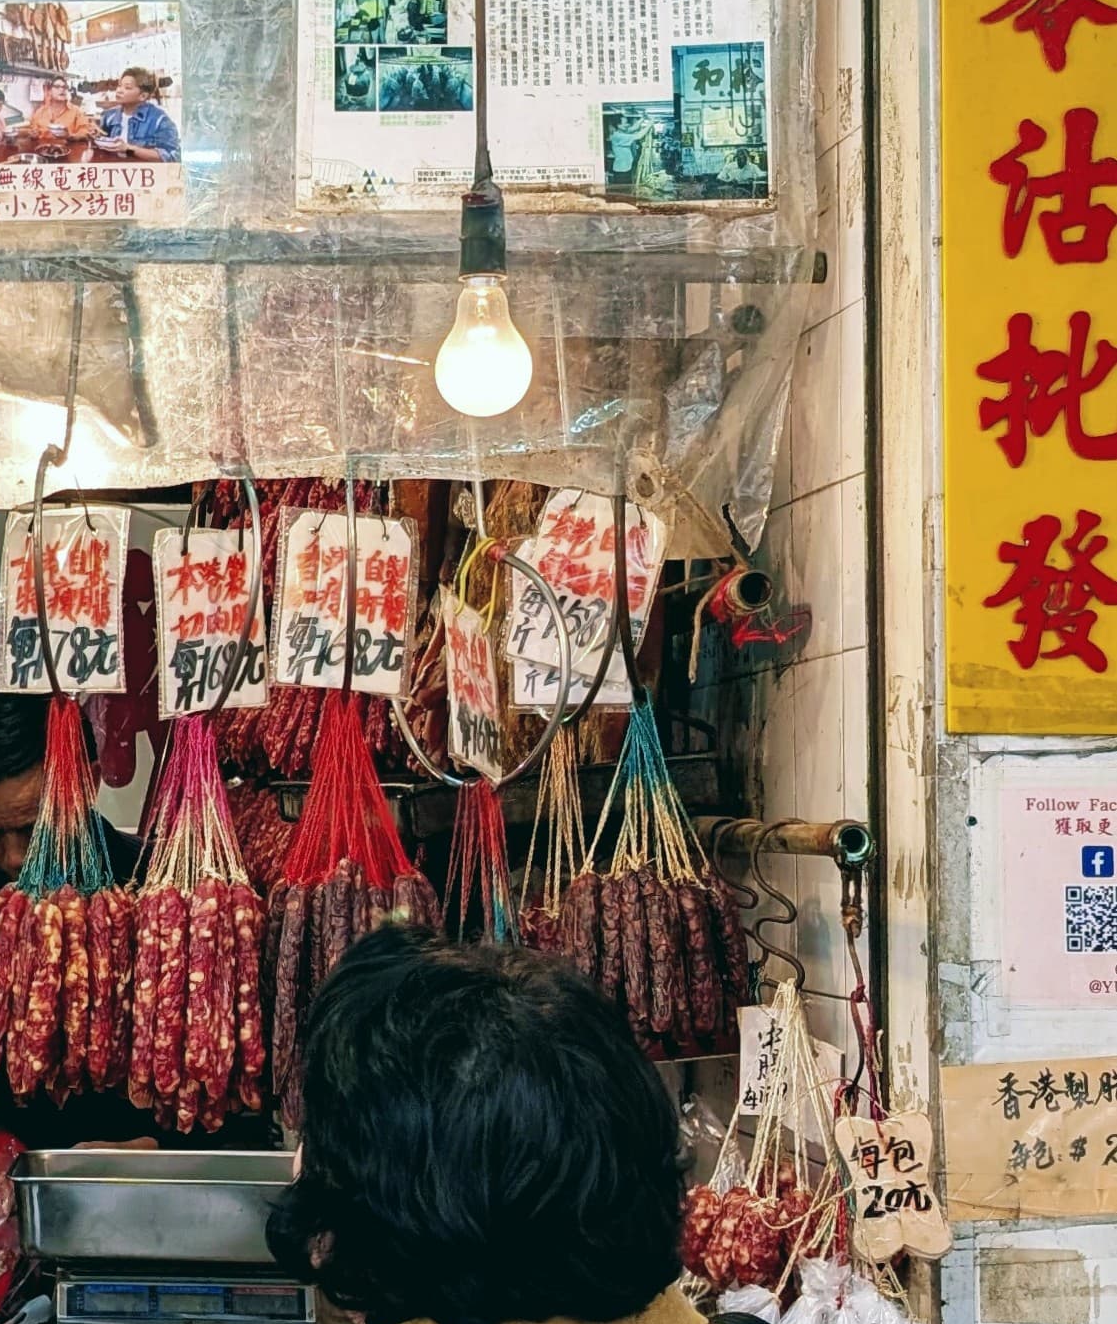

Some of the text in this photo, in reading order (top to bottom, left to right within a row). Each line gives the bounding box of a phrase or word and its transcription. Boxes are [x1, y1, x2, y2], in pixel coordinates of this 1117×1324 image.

[1026, 798, 1117, 811] Follow Fac
[1055, 817, 1113, 836] 獲取更
[850, 1135, 924, 1179] 每包
[860, 1180, 932, 1219] 20元
